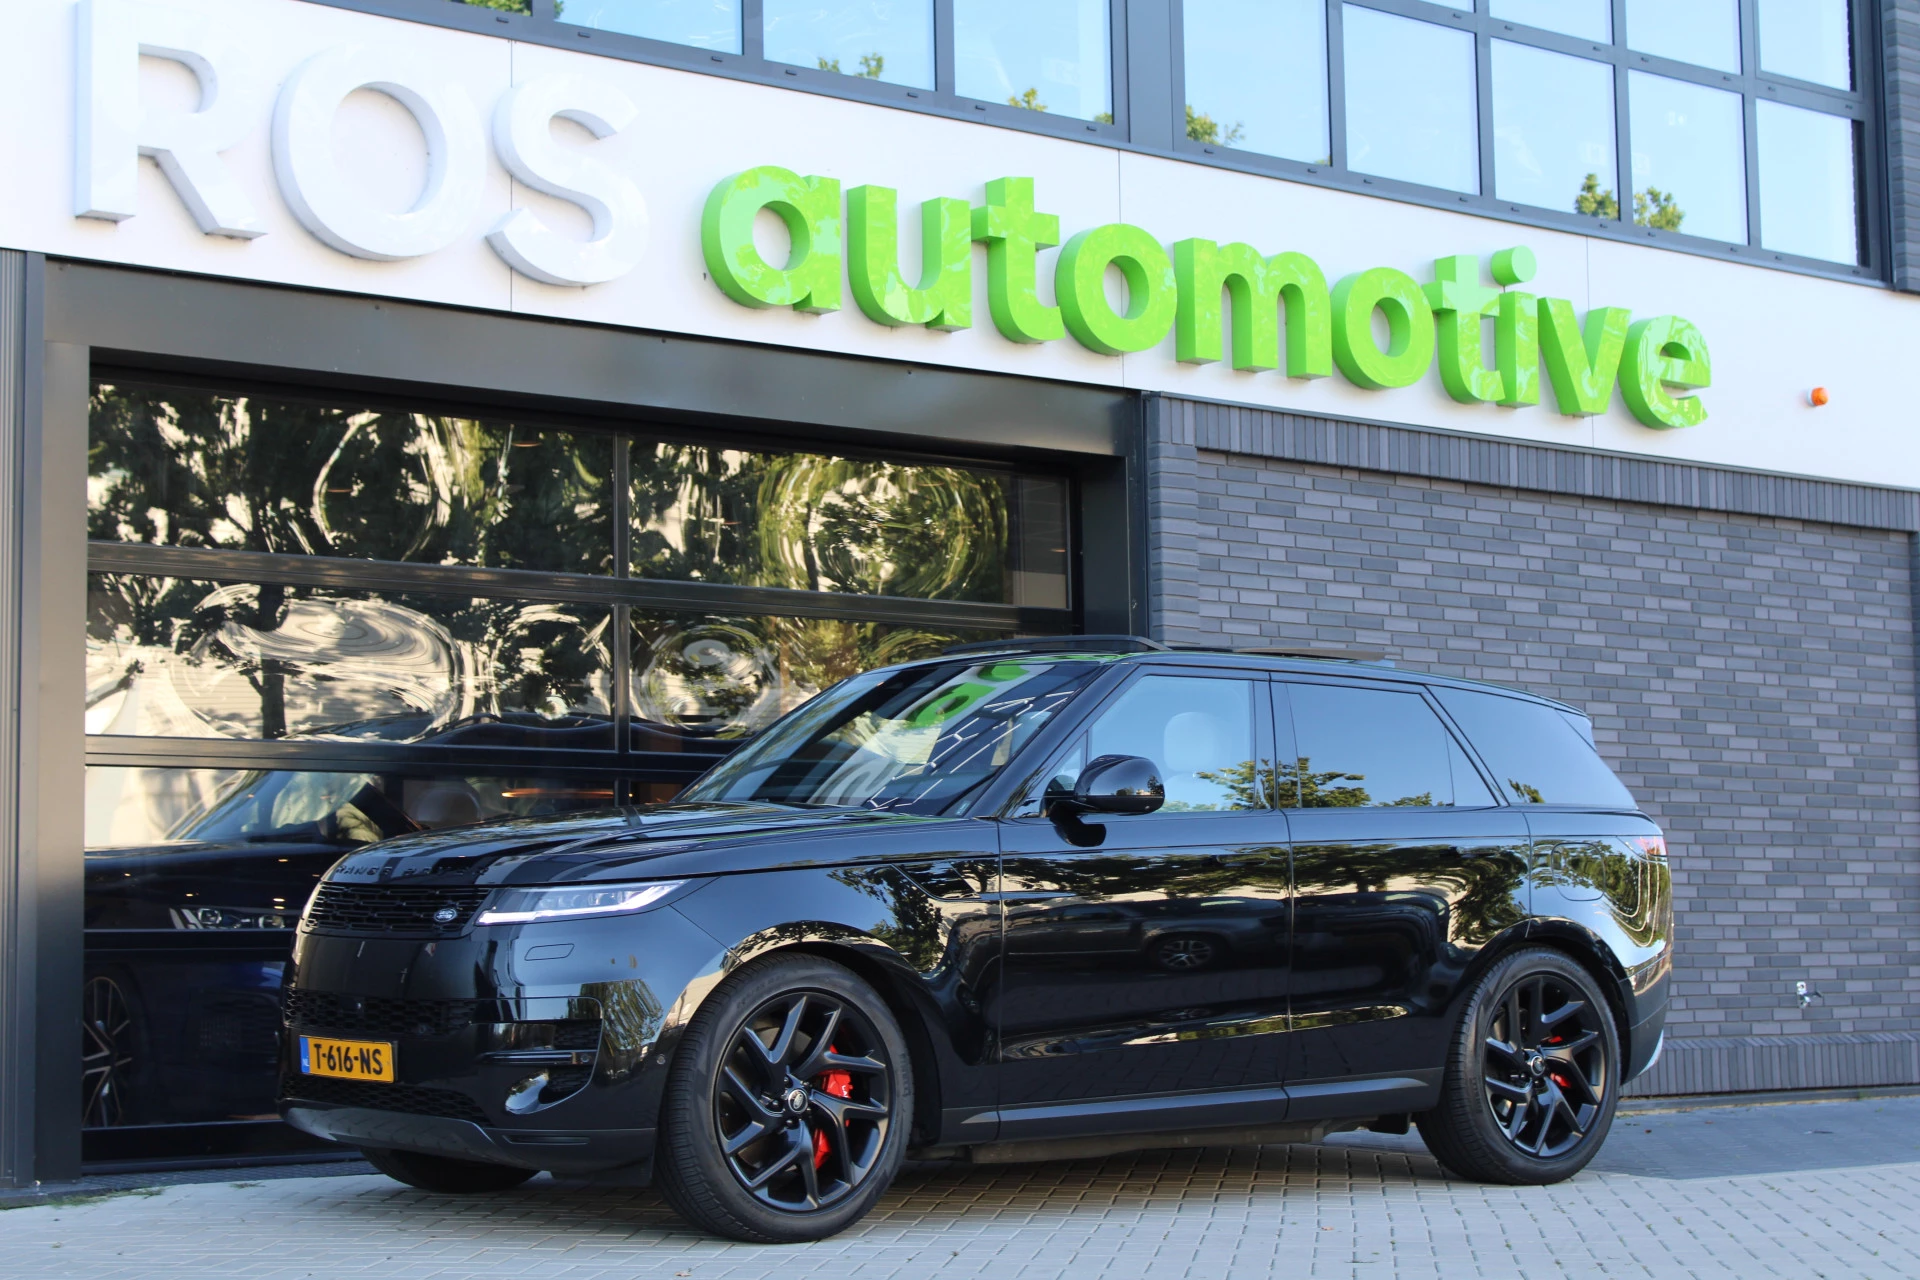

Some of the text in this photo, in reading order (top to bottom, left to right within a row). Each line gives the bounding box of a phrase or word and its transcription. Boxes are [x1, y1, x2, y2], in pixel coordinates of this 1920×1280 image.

[75, 0, 1710, 429] ROS automotive
[313, 1043, 384, 1076] T-616-NS
